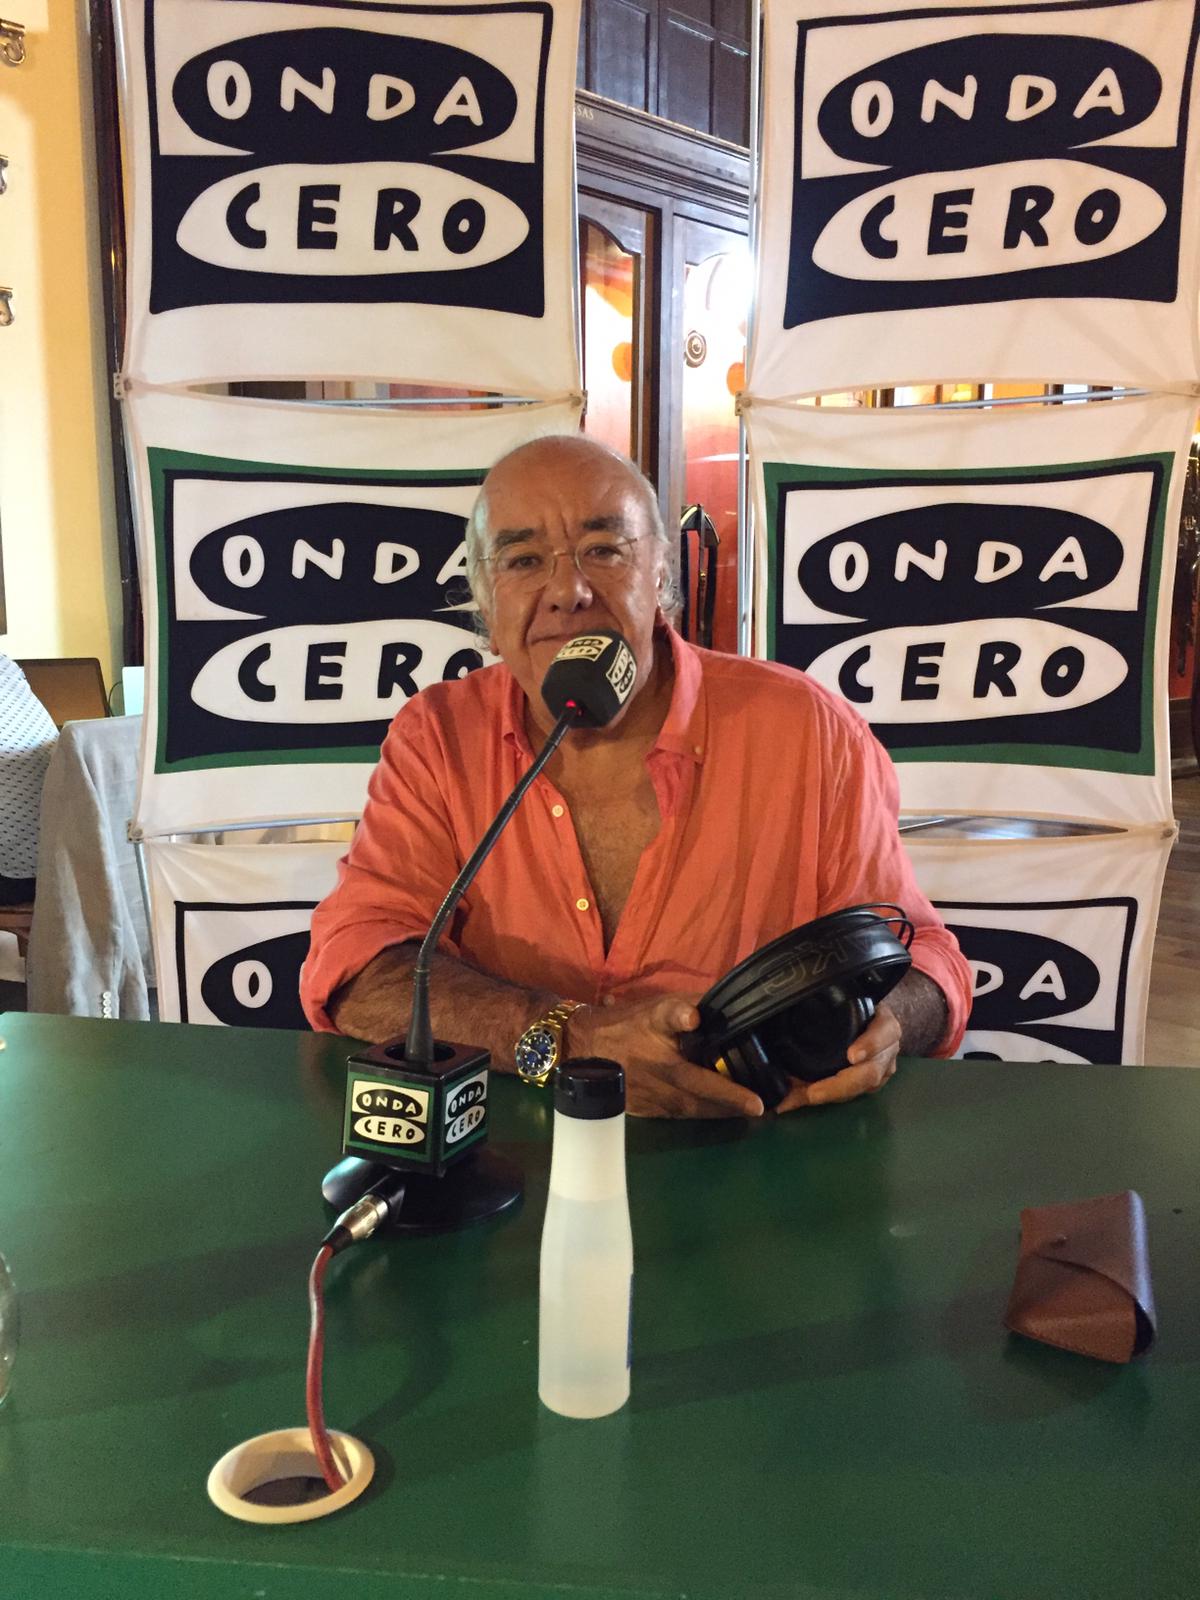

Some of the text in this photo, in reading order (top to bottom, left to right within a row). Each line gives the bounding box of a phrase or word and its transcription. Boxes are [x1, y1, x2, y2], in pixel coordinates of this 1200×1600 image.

[207, 60, 483, 126] ONDA
[575, 104, 594, 120] SAS
[851, 68, 1124, 137] ONDA
[226, 183, 485, 255] CERO
[861, 187, 1120, 259] CERO
[829, 536, 1088, 592] ONDA
[839, 641, 1084, 704] CERO
[971, 960, 1066, 1000] DA
[362, 1093, 416, 1114] ONDA
[451, 1086, 482, 1112] ONDA
[451, 1110, 479, 1136] CERO
[364, 1119, 415, 1138] CERO
